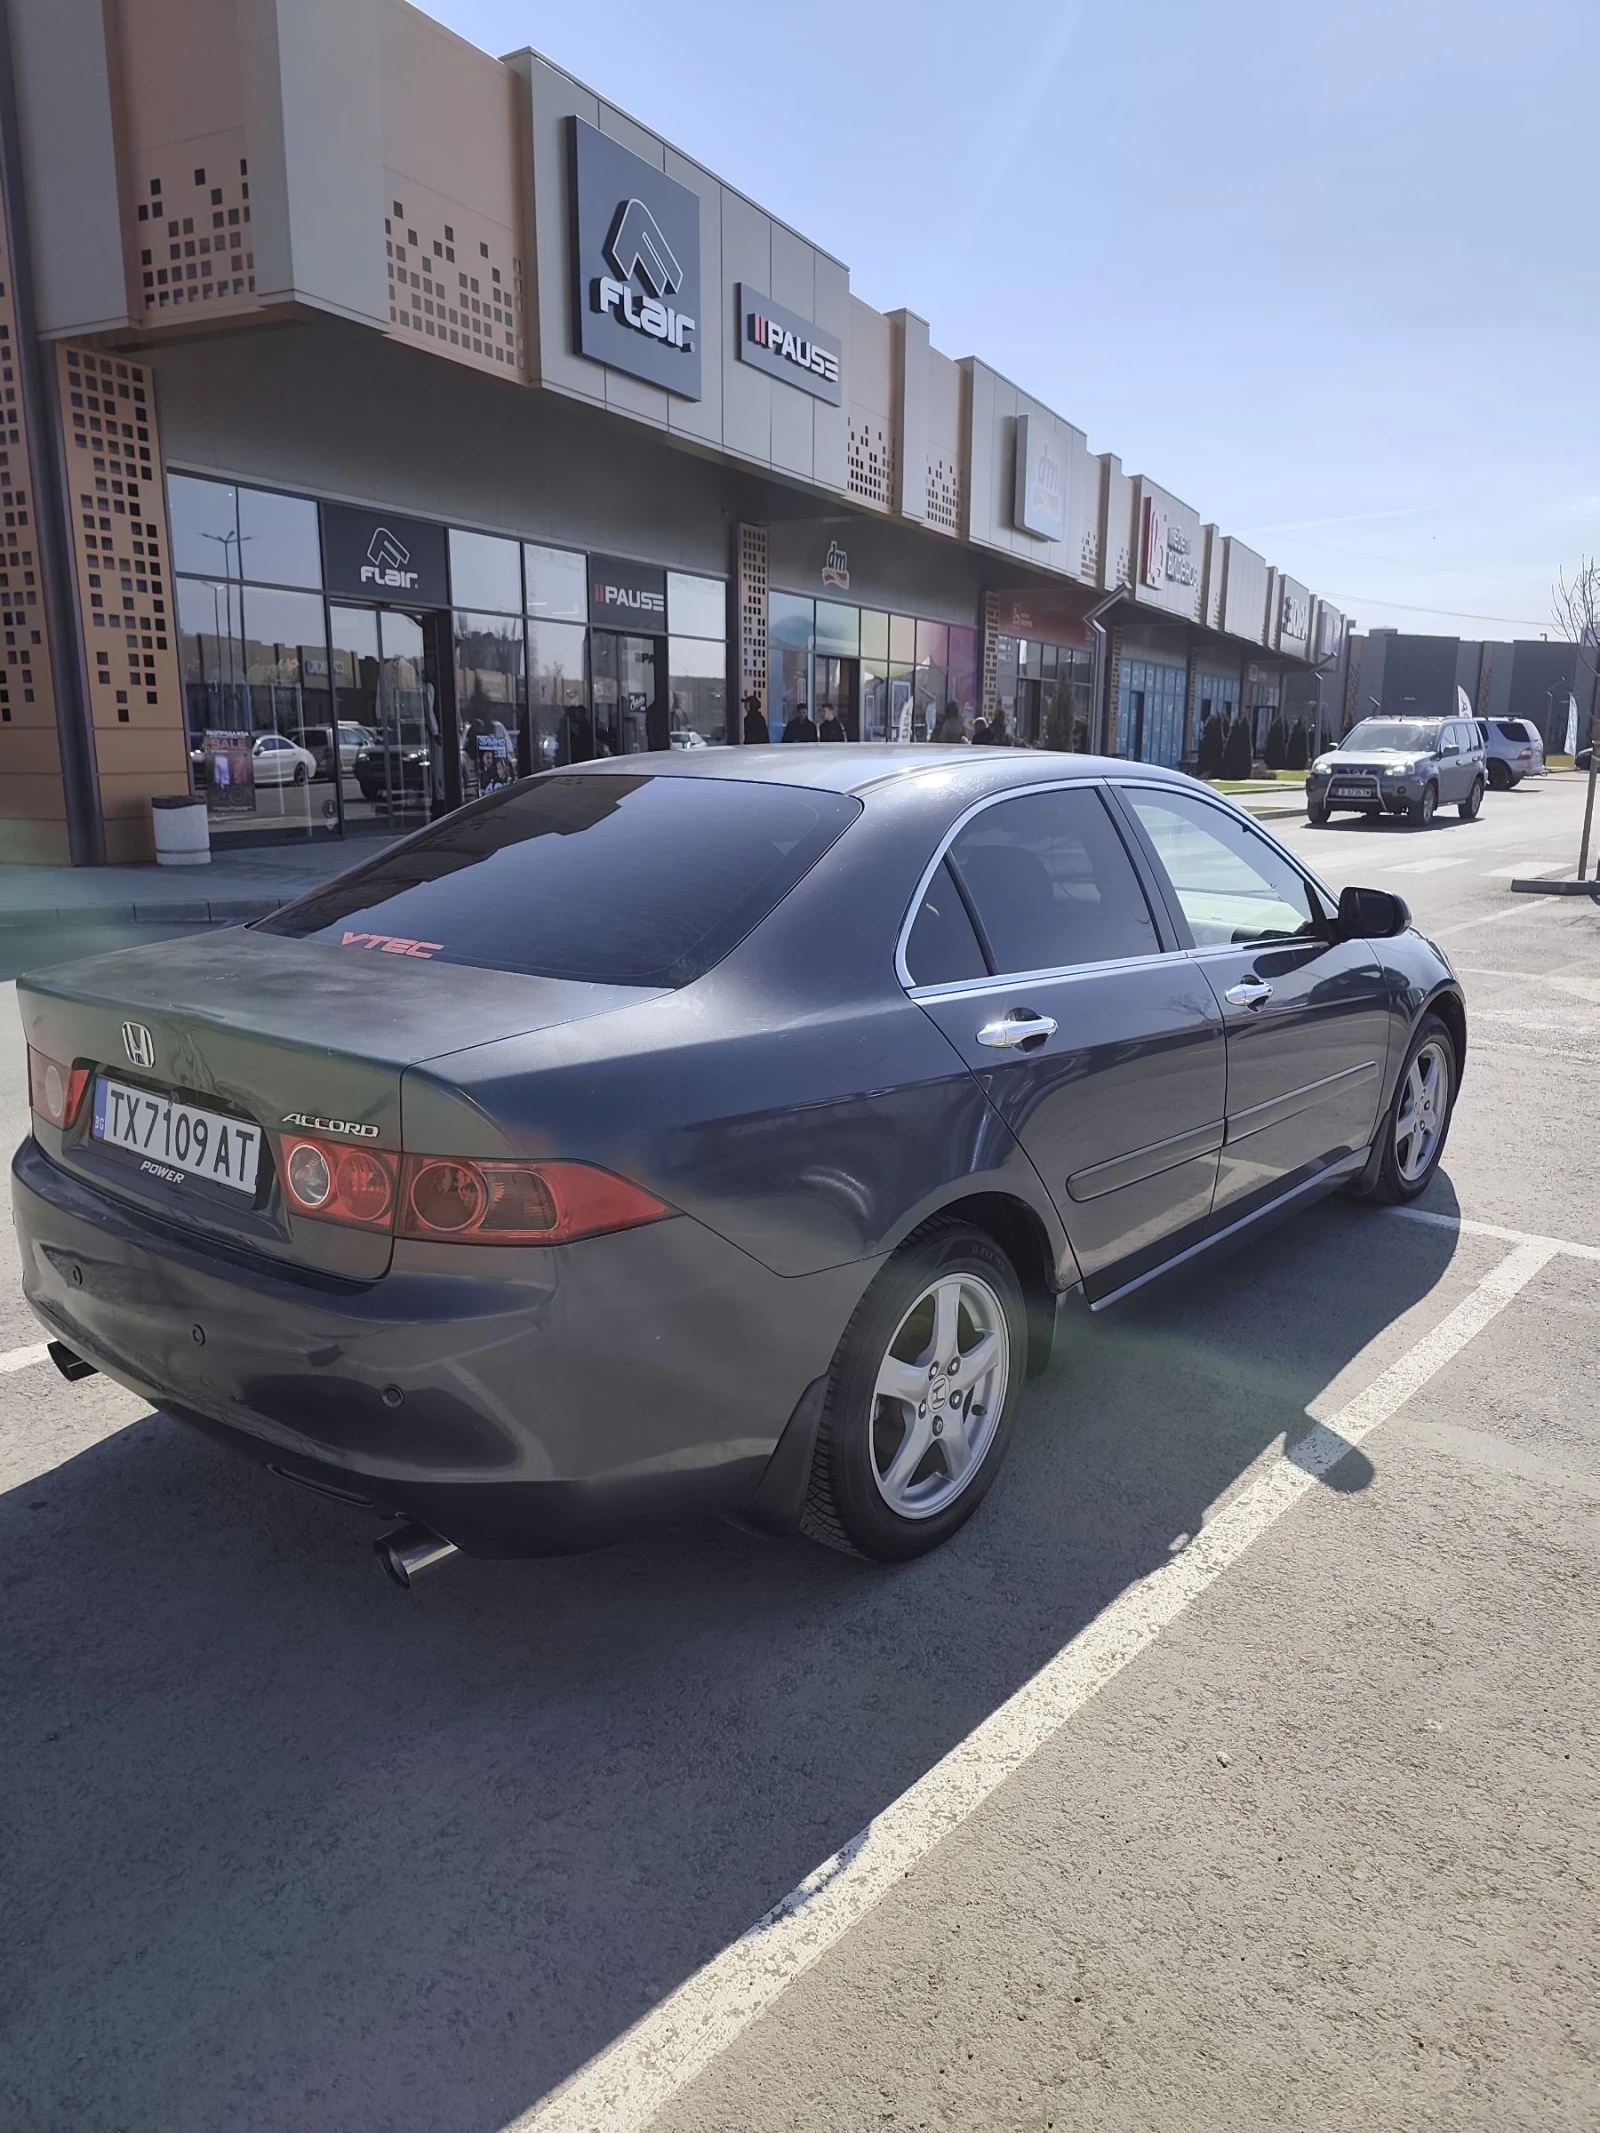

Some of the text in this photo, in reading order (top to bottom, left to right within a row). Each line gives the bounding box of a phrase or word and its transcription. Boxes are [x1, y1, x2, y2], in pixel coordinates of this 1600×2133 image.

[768, 324, 838, 382] PAUSE
[828, 543, 846, 571] dm
[605, 585, 664, 611] PAUSE
[211, 738, 247, 749] SALE
[342, 932, 445, 959] VTEC
[95, 1115, 104, 1131] BG
[281, 1113, 379, 1137] ACCORD
[140, 1160, 185, 1184] POWER
